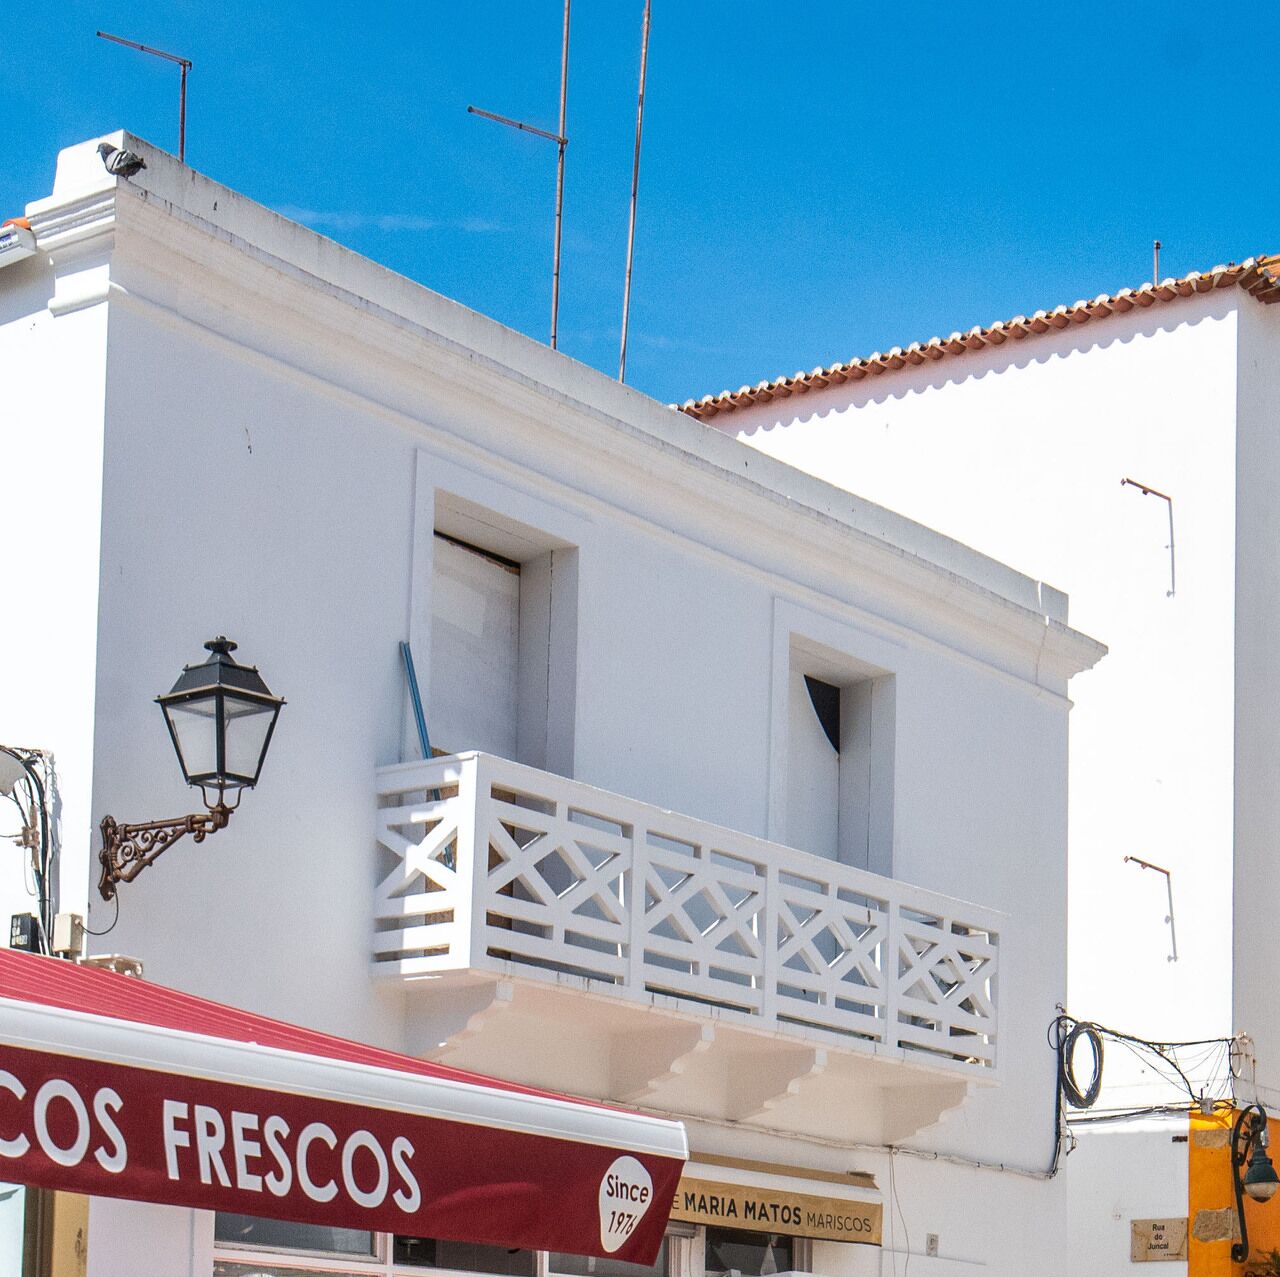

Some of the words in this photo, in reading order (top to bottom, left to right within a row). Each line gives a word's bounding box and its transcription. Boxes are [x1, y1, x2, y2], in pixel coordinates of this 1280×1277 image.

[162, 1098, 422, 1214] FRESCOS
[606, 1174, 649, 1203] Since
[608, 1210, 638, 1235] 1976
[684, 1191, 738, 1218] MARIA
[744, 1200, 802, 1226] MATOS
[807, 1211, 872, 1233] MARISCOS
[1147, 1242, 1169, 1250] Juncal
